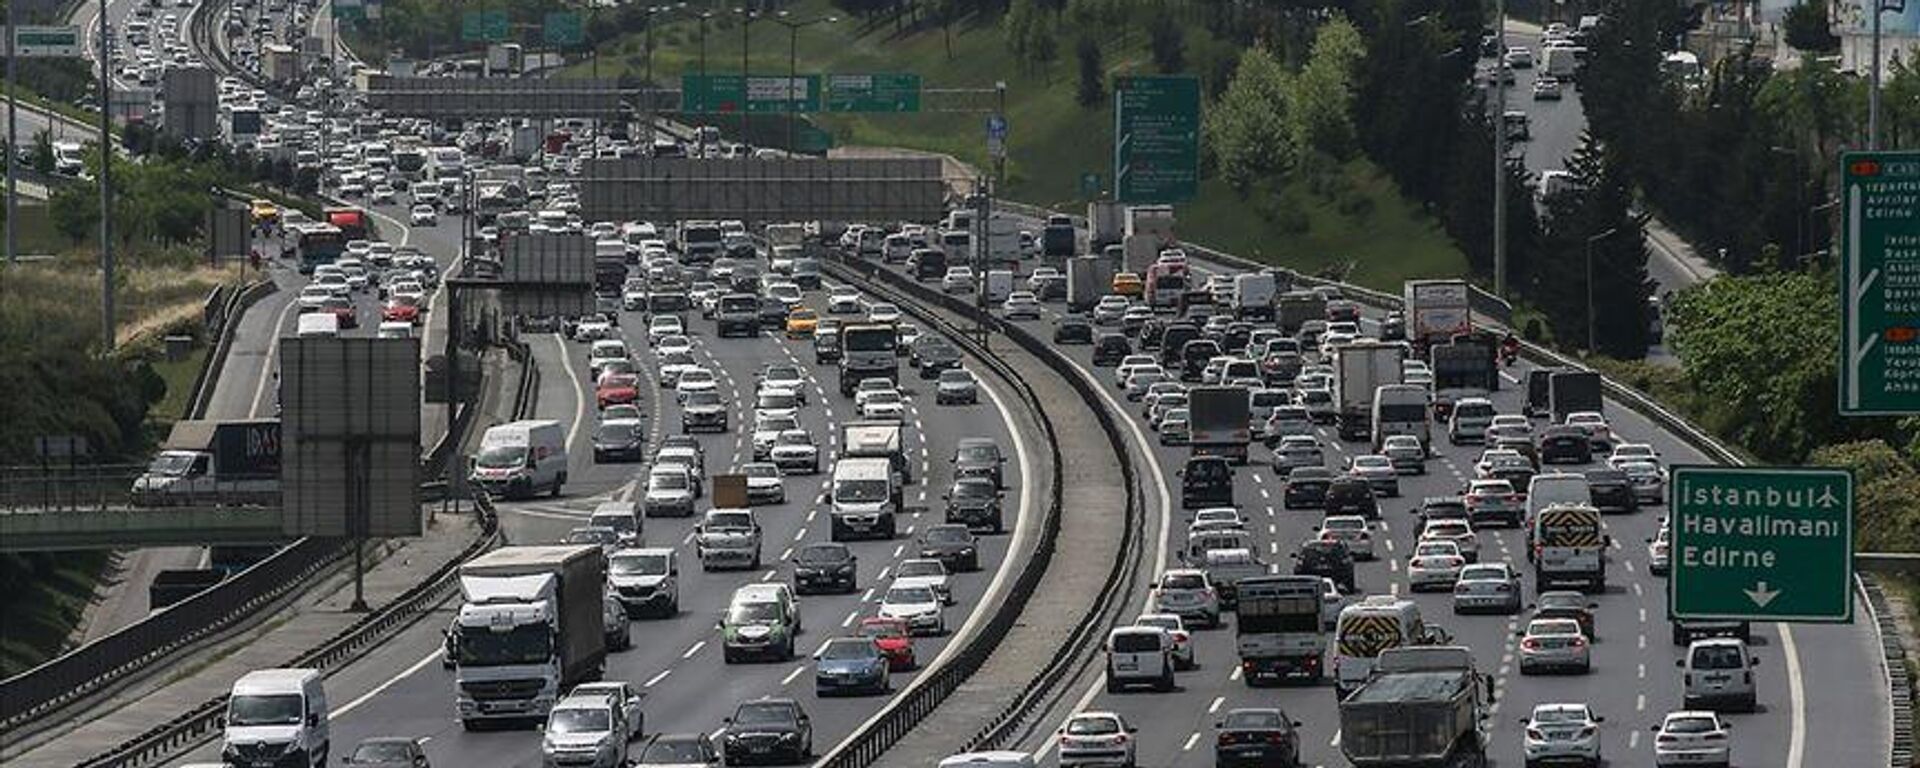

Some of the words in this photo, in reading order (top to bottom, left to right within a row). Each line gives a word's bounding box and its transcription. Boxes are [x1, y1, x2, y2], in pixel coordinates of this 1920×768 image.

[1683, 480, 1814, 507] İstanbul
[1683, 513, 1839, 537] Havalimanı
[1683, 546, 1777, 568] Edirne
